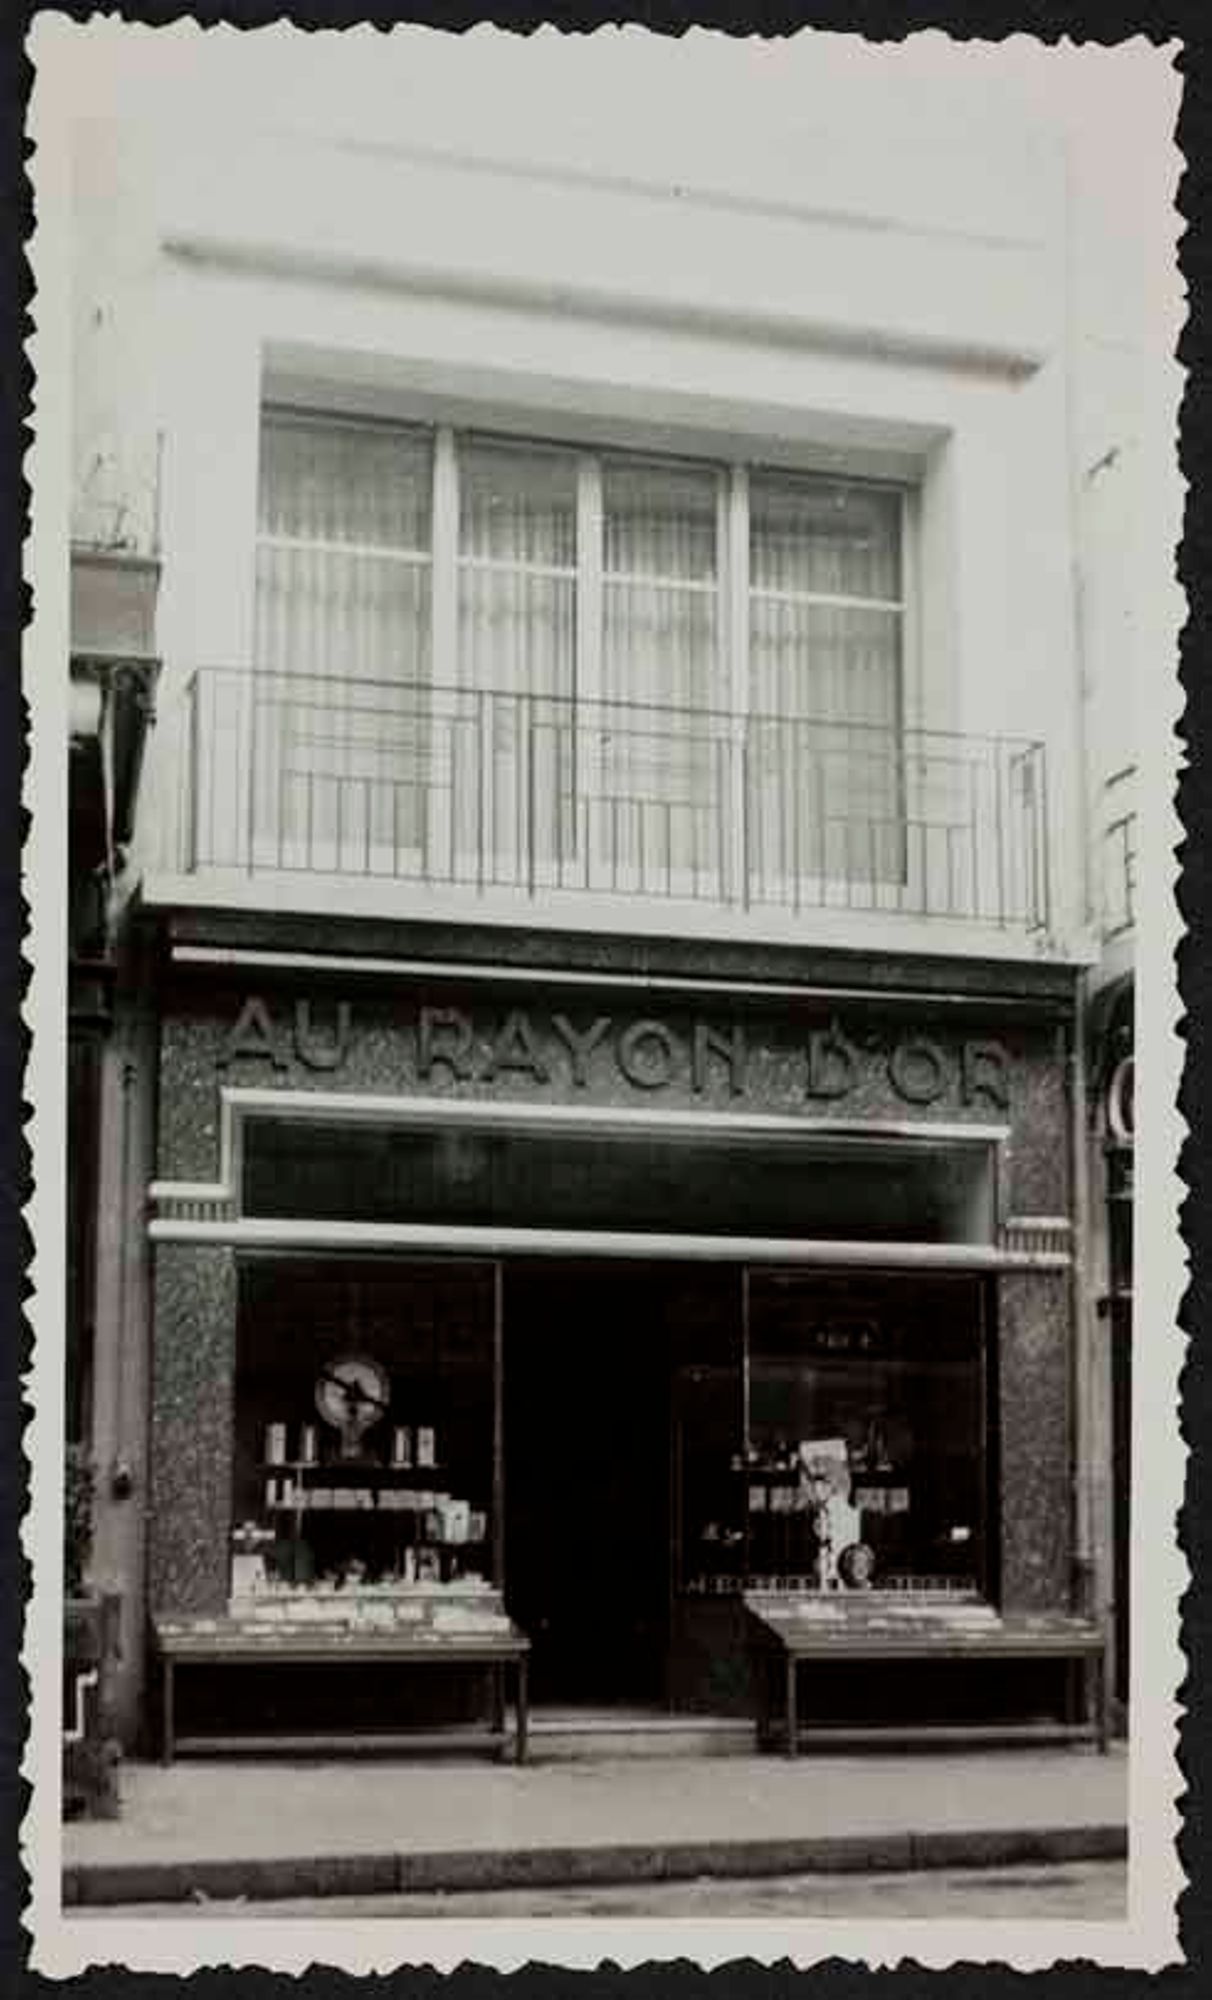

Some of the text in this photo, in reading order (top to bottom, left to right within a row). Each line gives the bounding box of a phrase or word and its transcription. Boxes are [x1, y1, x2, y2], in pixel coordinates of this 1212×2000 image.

[217, 996, 353, 1073] AU
[417, 1005, 744, 1097] RAYON
[805, 1026, 1010, 1108] D'OR
